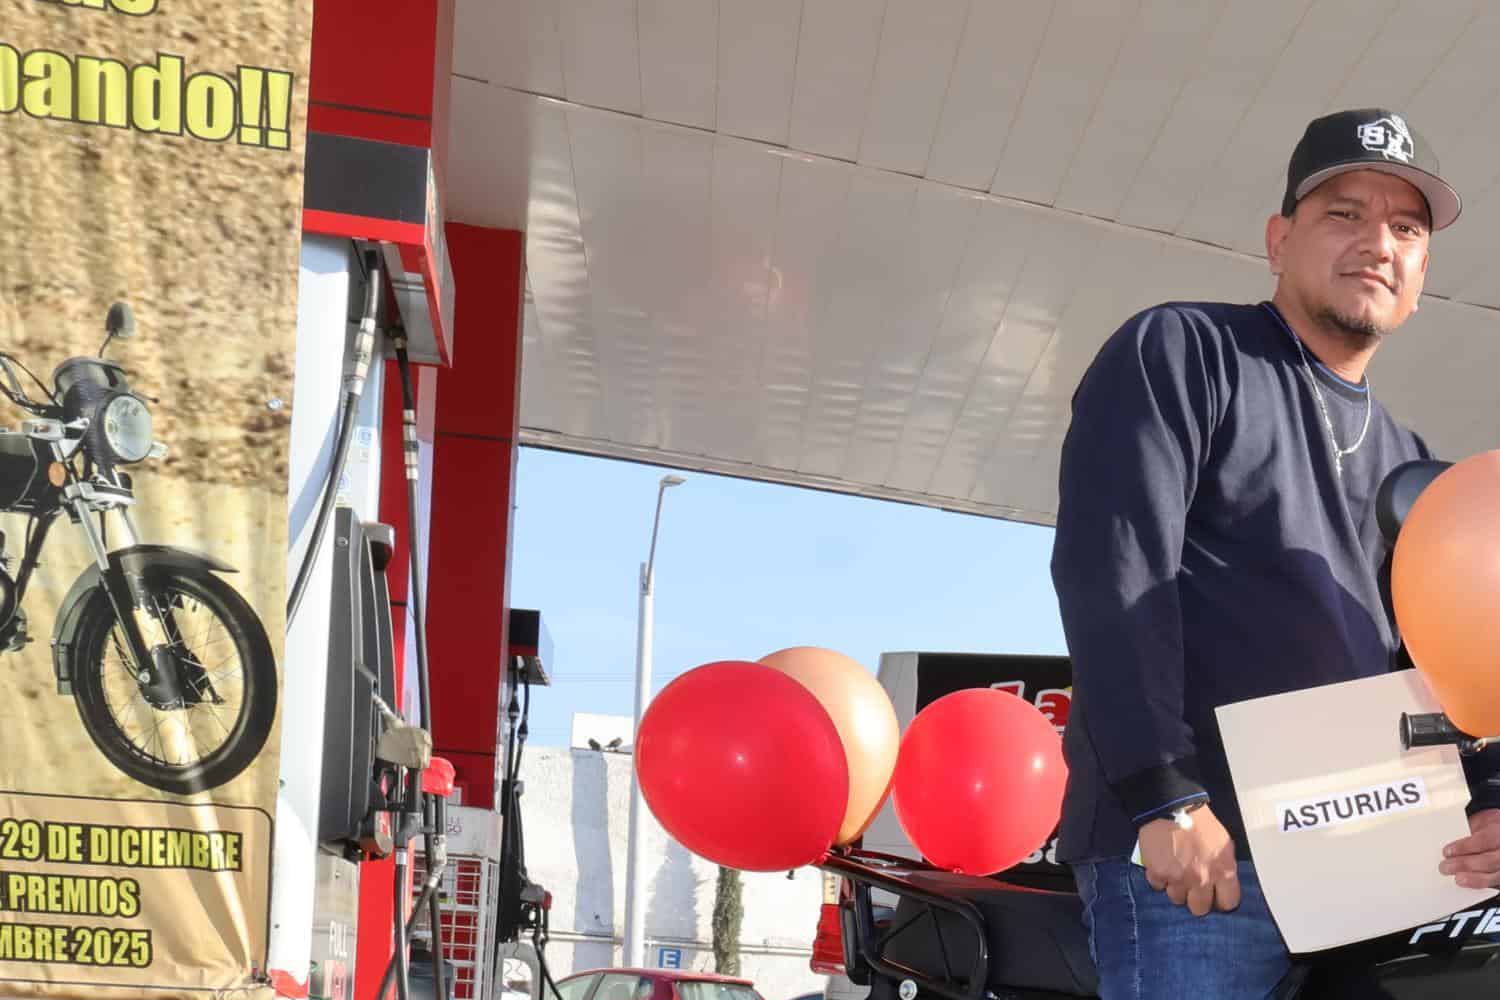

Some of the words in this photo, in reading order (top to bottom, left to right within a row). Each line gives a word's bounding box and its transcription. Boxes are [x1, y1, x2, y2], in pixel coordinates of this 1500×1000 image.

[1283, 782, 1421, 832] ASTURIAS
[2, 820, 41, 860] 29
[47, 823, 84, 862] DE
[89, 826, 240, 870] DICIEMBRE
[8, 873, 139, 917] PREMIOS
[75, 928, 150, 966] 2025
[663, 949, 677, 969] E
